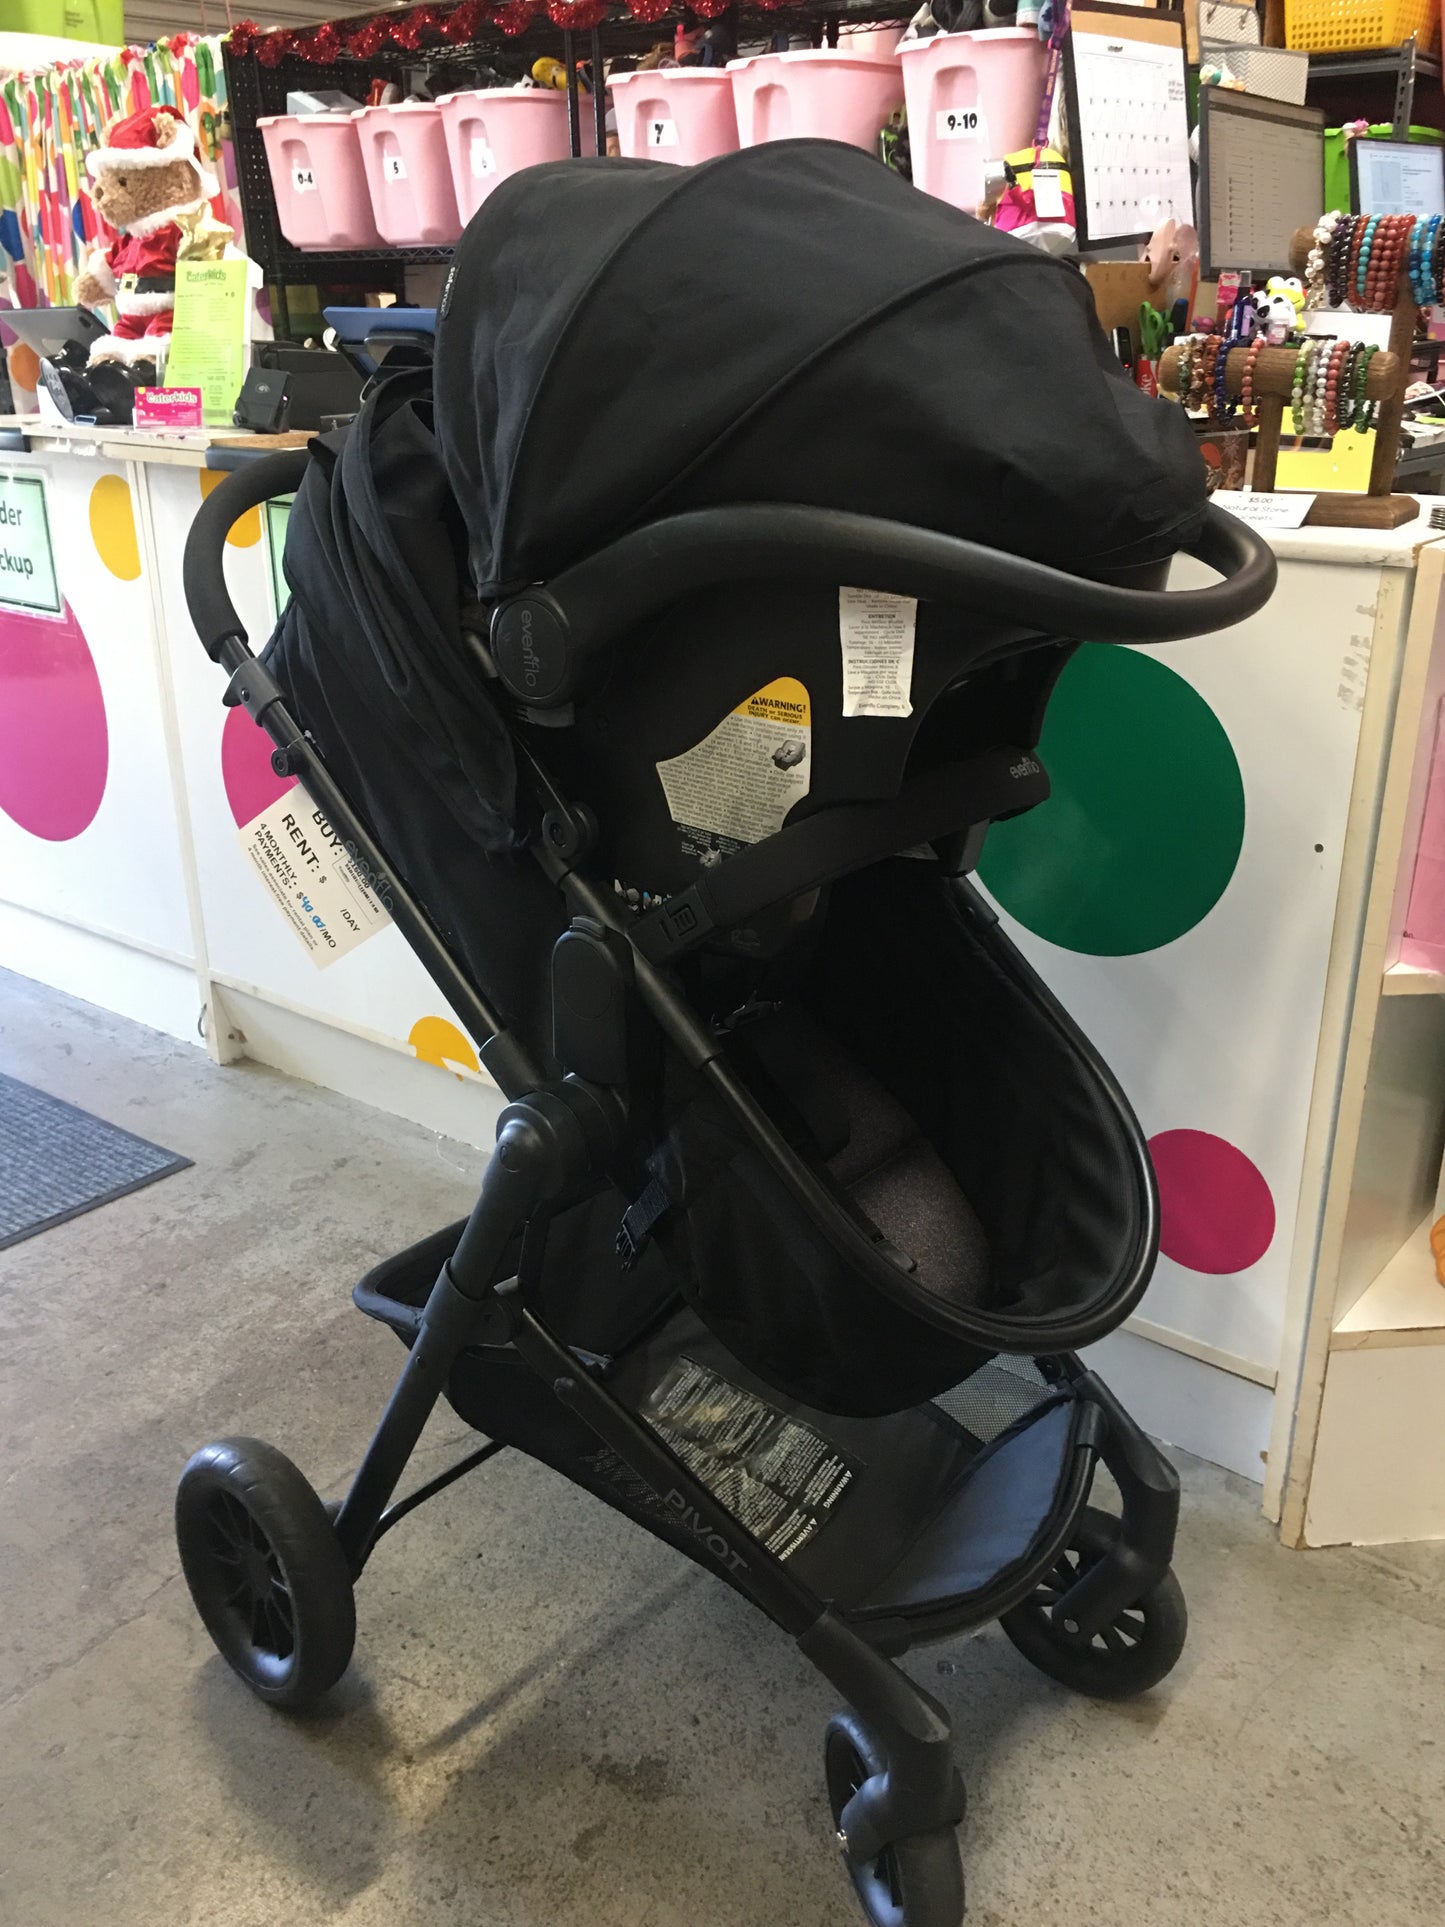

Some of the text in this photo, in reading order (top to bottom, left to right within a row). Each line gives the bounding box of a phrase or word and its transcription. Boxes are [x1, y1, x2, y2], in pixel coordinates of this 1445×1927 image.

[948, 112, 978, 130] 9-10
[394, 162, 399, 174] 5
[521, 609, 541, 687] evenflo
[759, 697, 806, 713] WARNING!
[777, 711, 802, 719] SERIOUS
[264, 830, 298, 880] MONTHLY
[312, 810, 344, 856] BUY:
[282, 813, 320, 873] RENT:
[319, 876, 327, 884] $
[340, 908, 361, 933] /DAY
[346, 840, 393, 912] evenflo
[823, 1476, 849, 1508] WARNING
[662, 1488, 749, 1570] PIVOT
